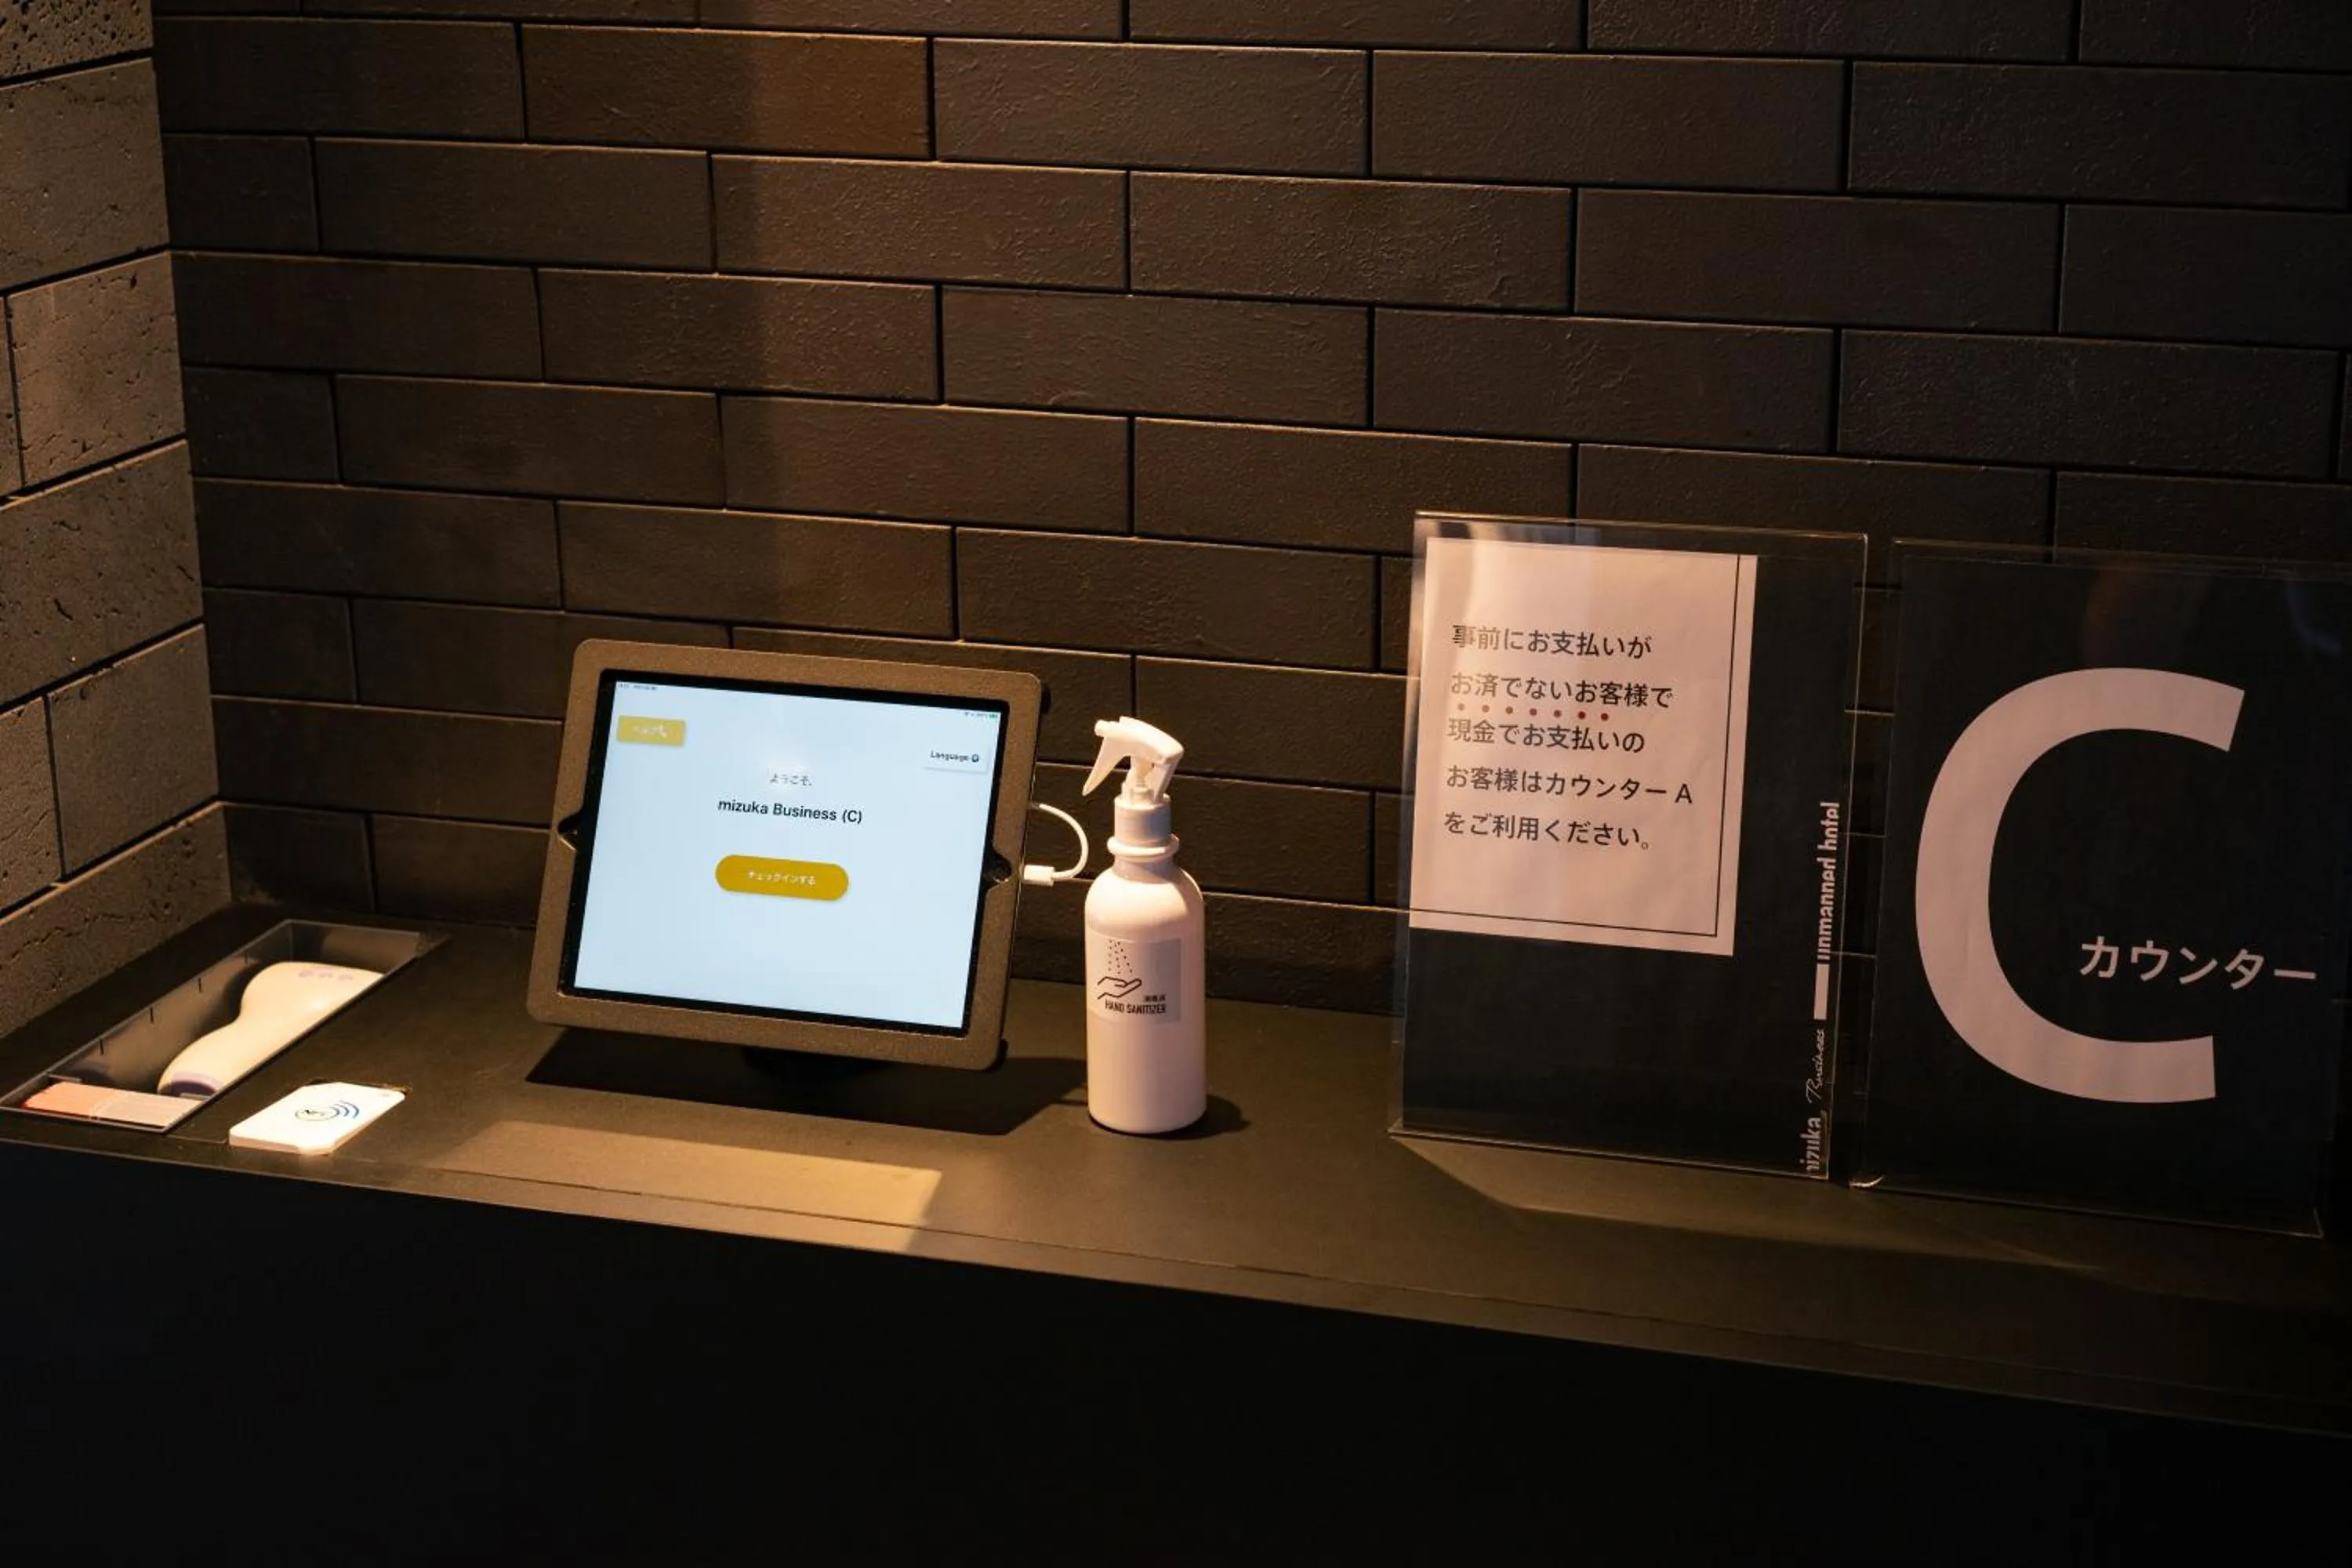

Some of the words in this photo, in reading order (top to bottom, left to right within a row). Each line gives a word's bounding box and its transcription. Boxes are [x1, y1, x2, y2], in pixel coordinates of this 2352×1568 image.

[1452, 625, 1652, 659] 事前にお支払いが
[1450, 672, 1673, 708] お済でないお客様で
[1447, 717, 1645, 753] 現金でお支払いの
[931, 750, 969, 762] Language
[717, 798, 768, 815] mizuka
[772, 802, 837, 822] Business
[841, 809, 862, 824] (C)
[1817, 801, 1840, 851] hotel
[1444, 811, 1649, 851] をご利用ください。
[1915, 667, 2245, 1103] C
[2078, 935, 2318, 990] カウンター
[1105, 999, 1125, 1013] HAND
[1127, 1003, 1167, 1014] SANITIZER
